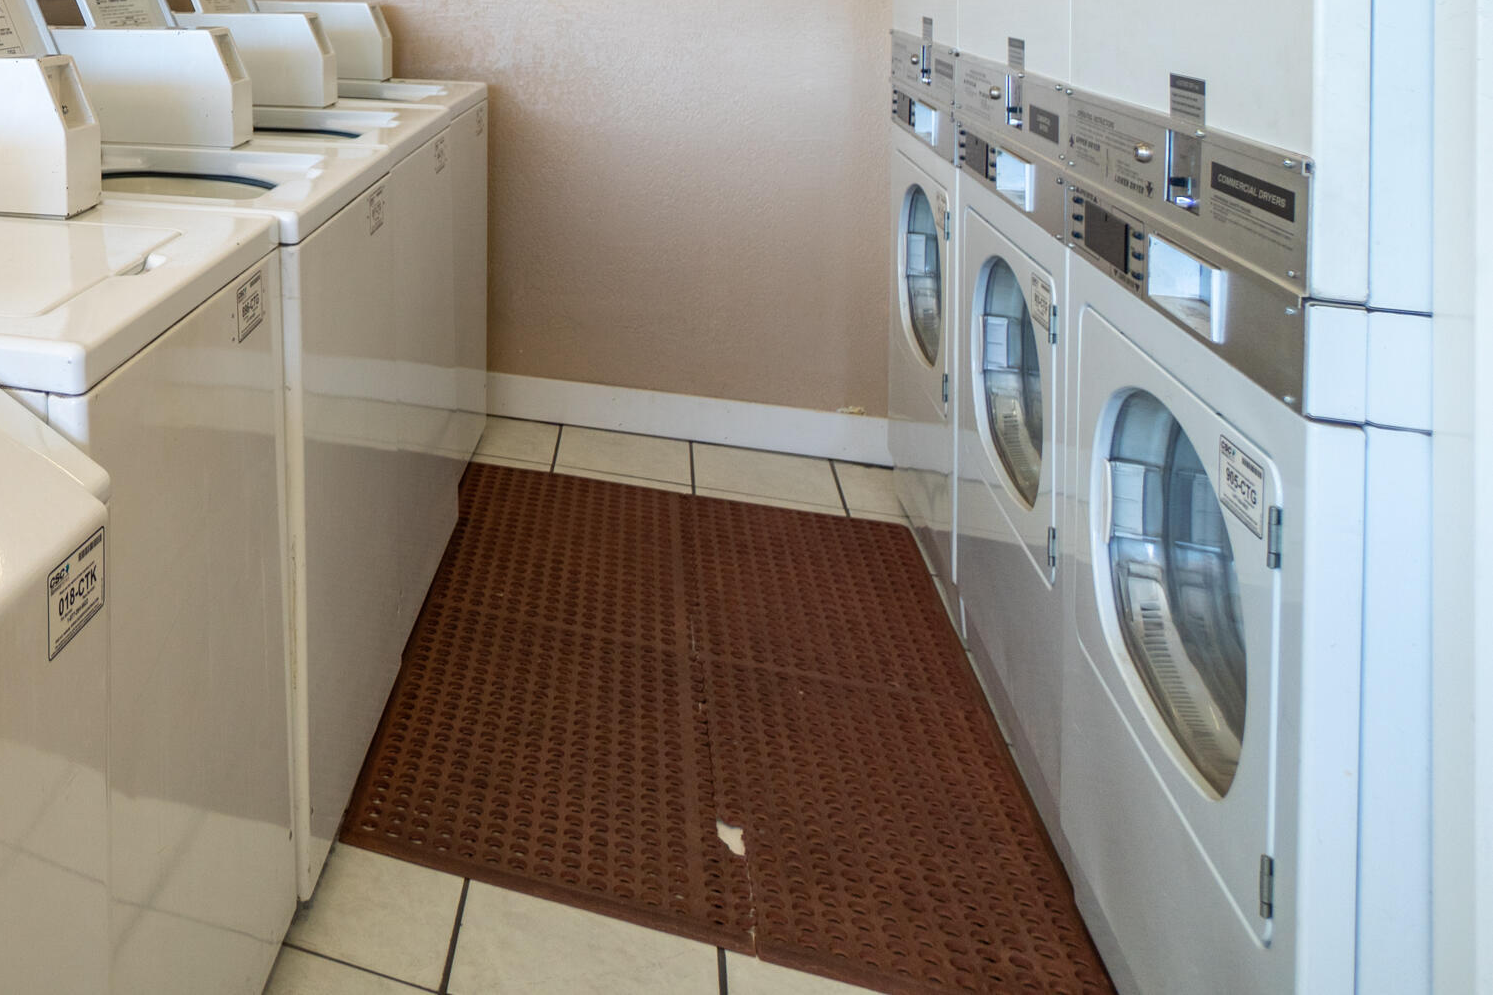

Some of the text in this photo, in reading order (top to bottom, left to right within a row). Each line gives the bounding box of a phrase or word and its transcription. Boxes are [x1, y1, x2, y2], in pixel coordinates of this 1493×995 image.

[1217, 174, 1286, 208] COMMERCIAL DRYERS
[1226, 468, 1256, 505] 905-CTG
[50, 568, 65, 589] CSC
[58, 564, 97, 617] 018-CTK
